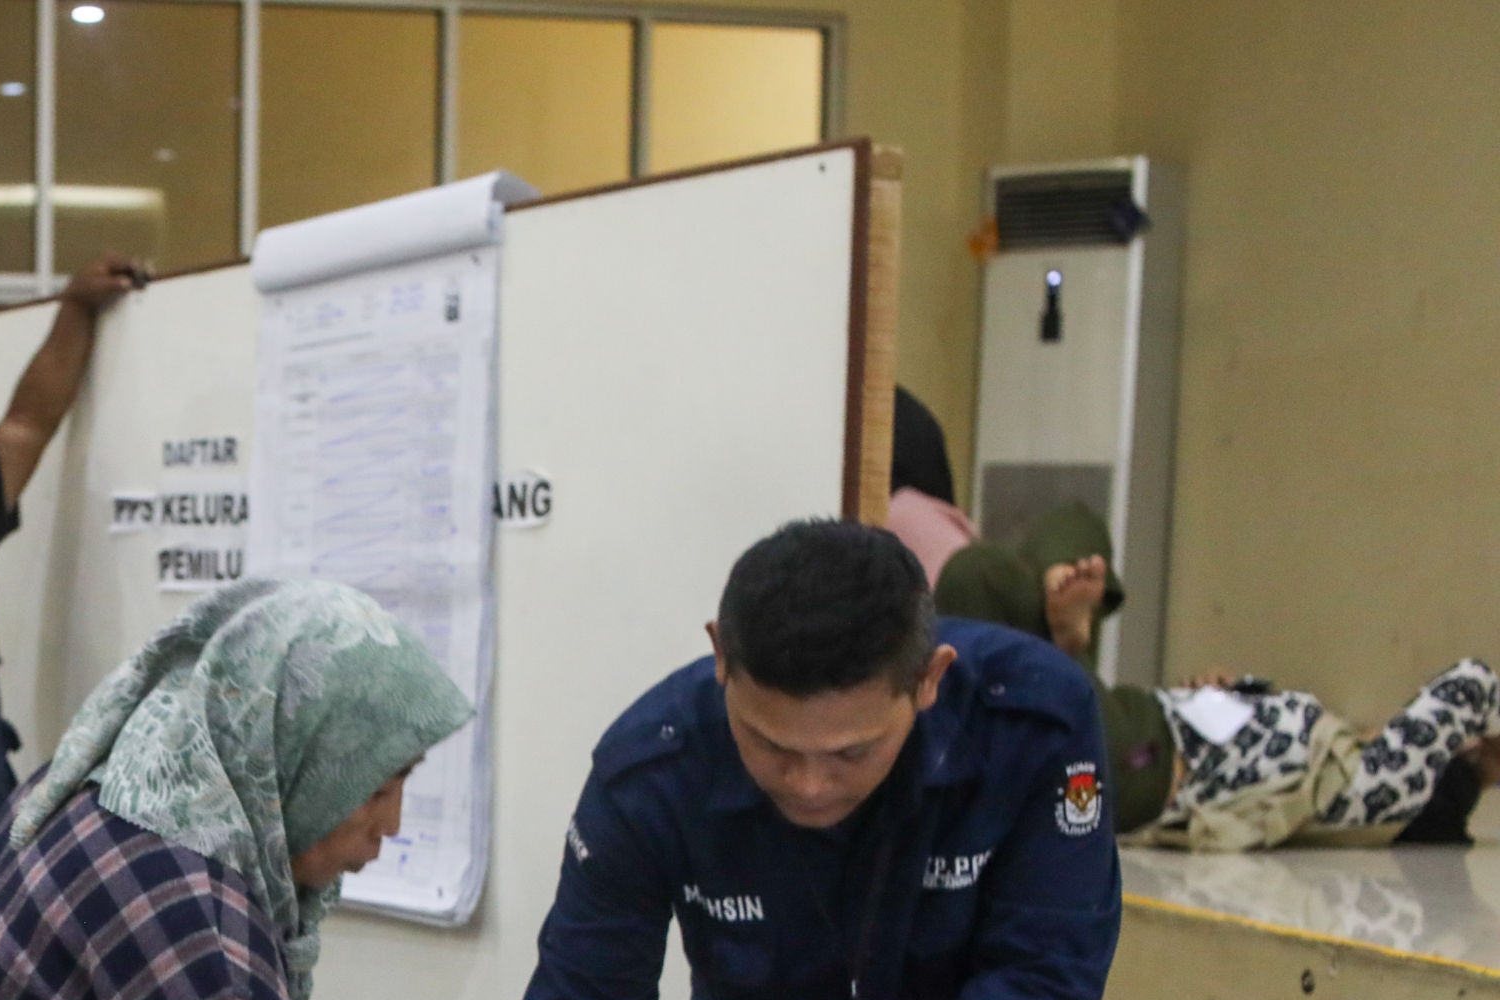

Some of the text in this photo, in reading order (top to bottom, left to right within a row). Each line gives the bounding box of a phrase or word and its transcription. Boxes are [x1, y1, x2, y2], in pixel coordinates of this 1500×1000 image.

[163, 437, 238, 467] DAFTAR
[158, 549, 242, 580] PEMILU
[683, 883, 765, 923] MHSIN
